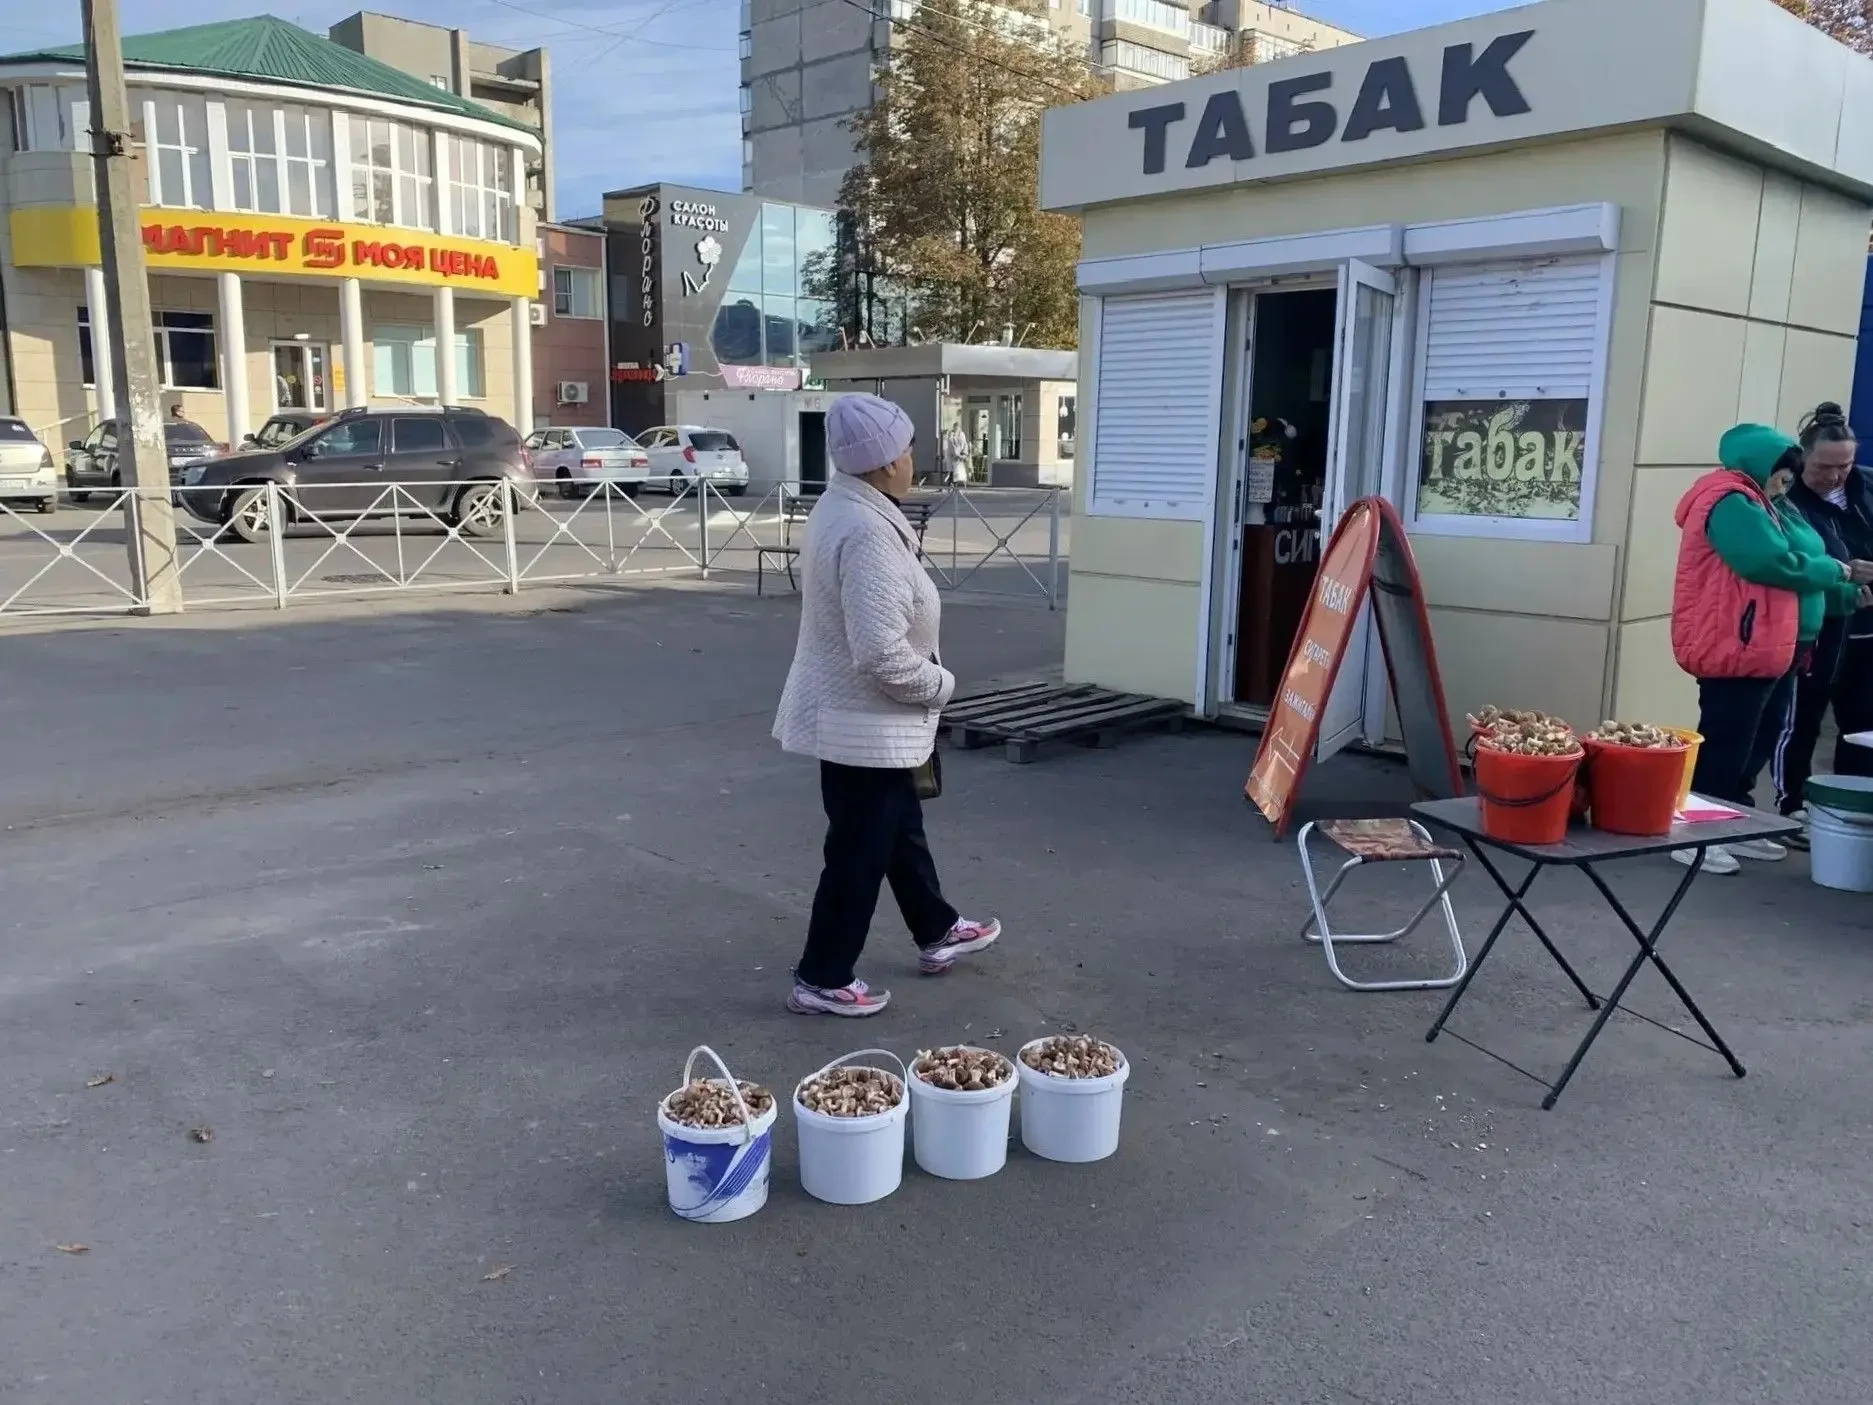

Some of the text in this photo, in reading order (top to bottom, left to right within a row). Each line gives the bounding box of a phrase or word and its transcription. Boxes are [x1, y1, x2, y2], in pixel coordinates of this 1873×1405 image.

[1128, 29, 1535, 175] ТАБАК
[672, 200, 716, 215] САЛОН
[673, 214, 729, 232] КРАСОТЫ
[353, 240, 425, 270] МОЯ
[429, 248, 499, 280] ЦЕНА
[1319, 575, 1352, 615] ТАБАК
